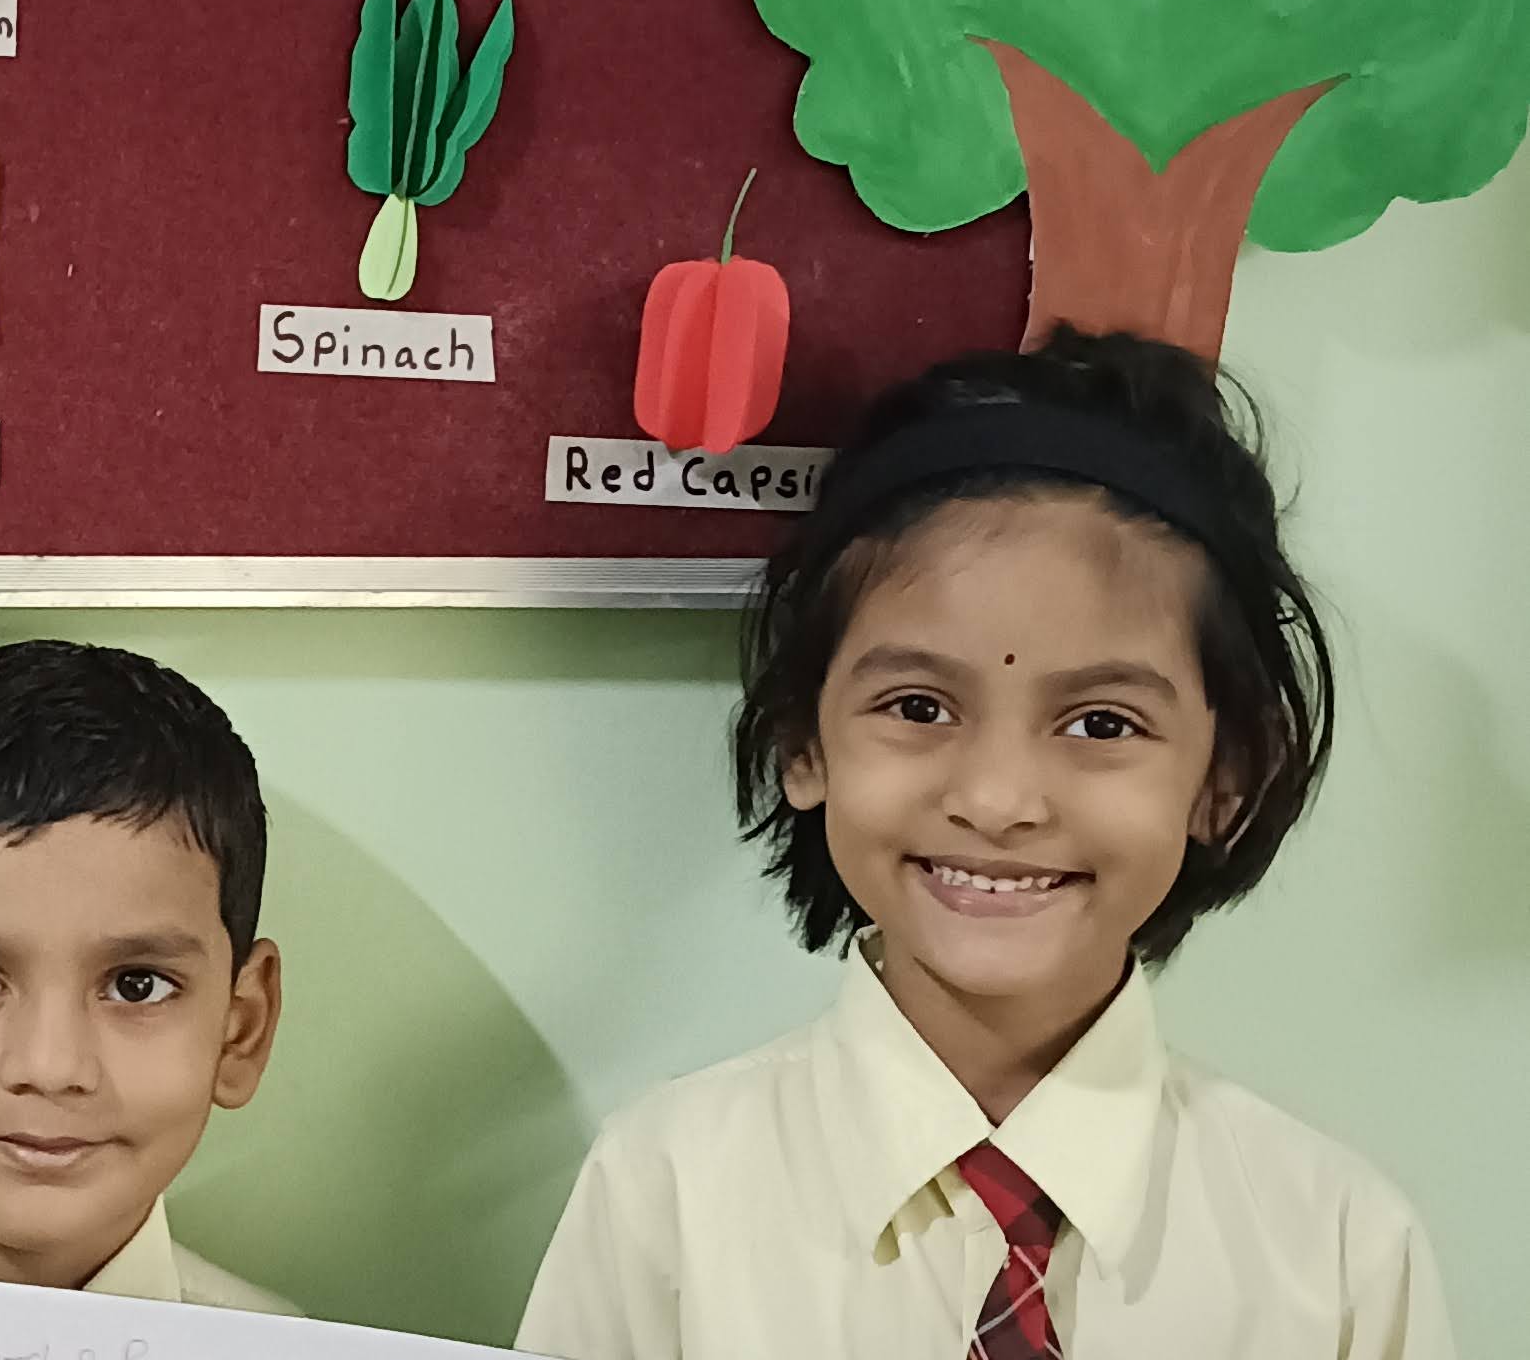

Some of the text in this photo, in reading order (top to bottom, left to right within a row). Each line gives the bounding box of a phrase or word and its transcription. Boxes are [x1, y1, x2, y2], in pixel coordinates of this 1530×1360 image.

[272, 310, 475, 372] Spinach
[564, 446, 816, 501] Red Capsi
